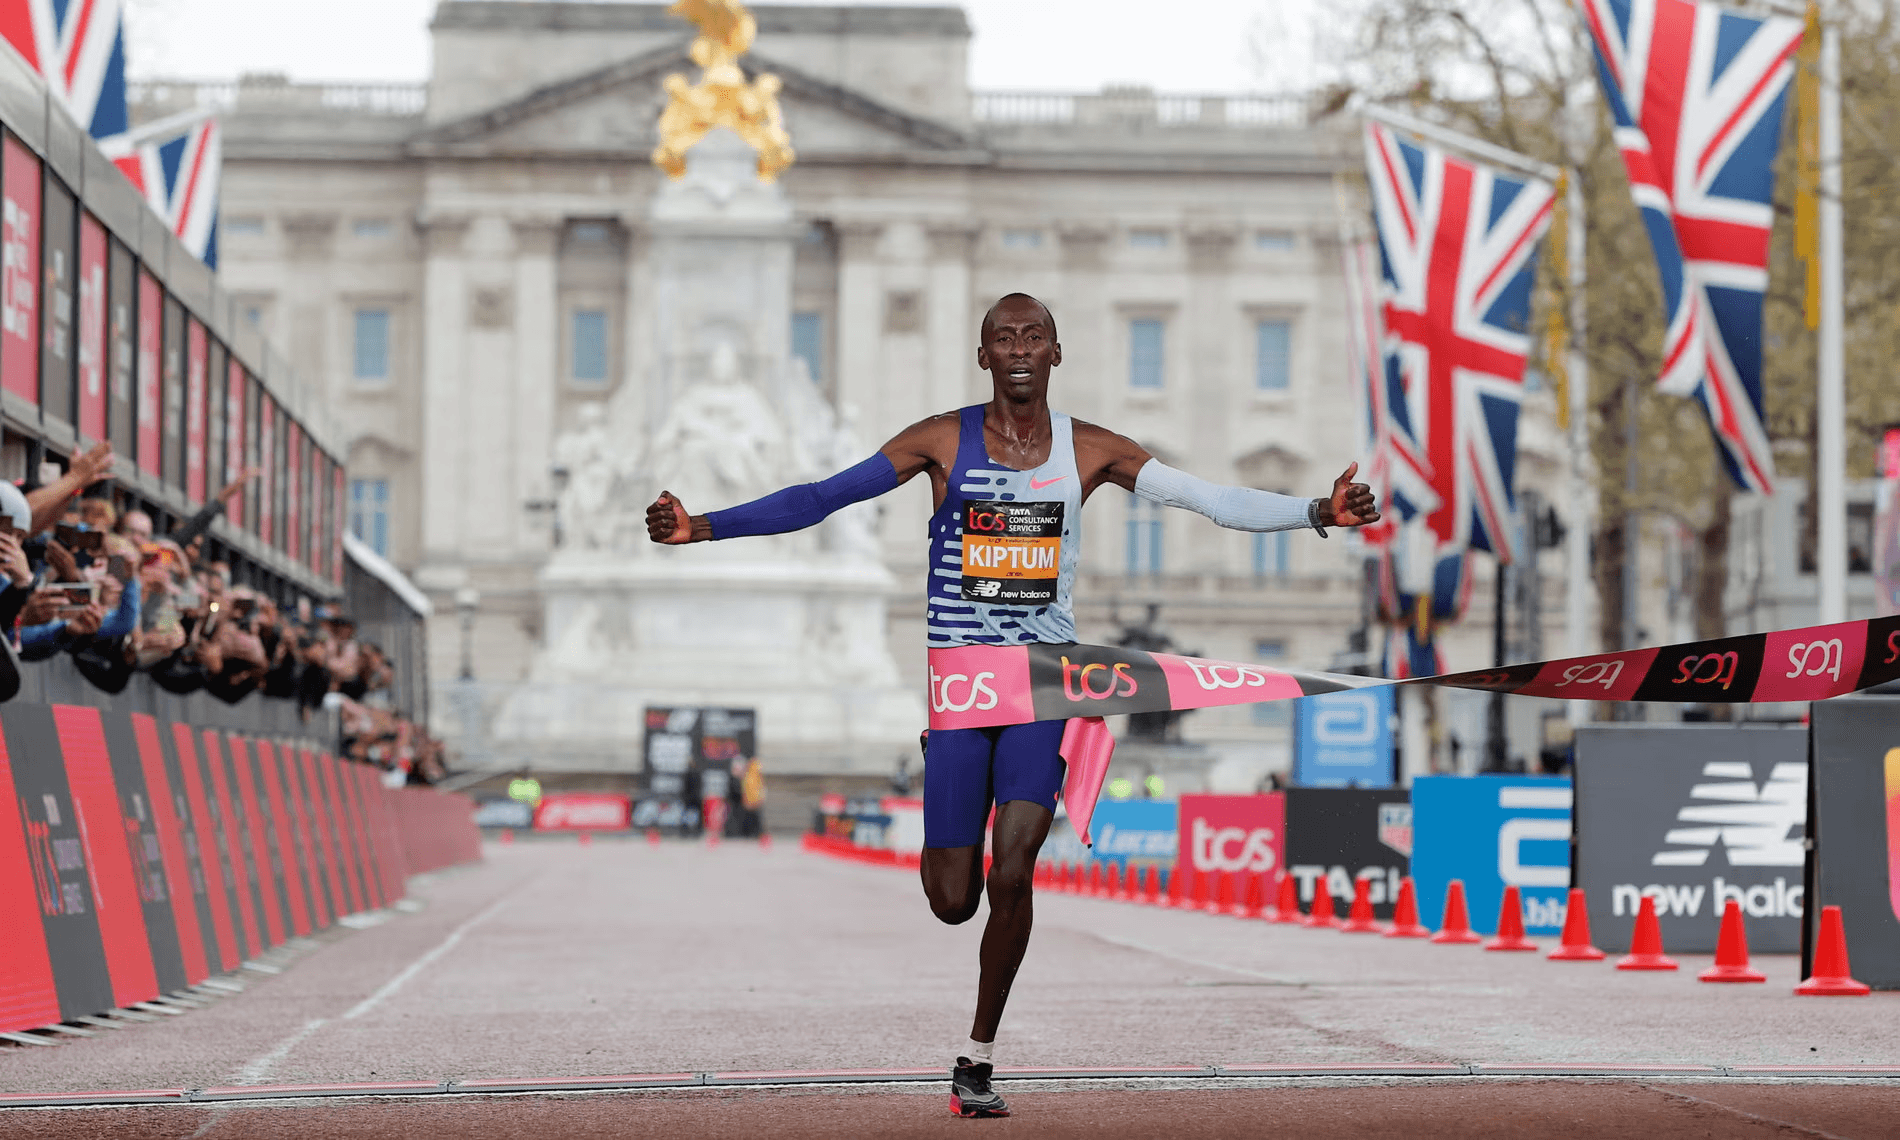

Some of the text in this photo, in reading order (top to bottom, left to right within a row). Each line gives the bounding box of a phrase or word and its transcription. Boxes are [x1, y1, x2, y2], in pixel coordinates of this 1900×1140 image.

[969, 507, 1006, 531] tcs
[1008, 516, 1058, 524] CONSULTANCY
[1009, 508, 1031, 516] TATA
[1008, 524, 1041, 532] SERVICES
[969, 544, 1055, 569] KIPTUM
[1185, 660, 1266, 690] tcs
[1555, 659, 1625, 690] tcs
[1672, 651, 1738, 690] tcs
[1786, 638, 1843, 682] tcs
[930, 664, 998, 713] tcs
[1061, 656, 1137, 701] tcs
[1192, 817, 1276, 872] tcs
[1612, 883, 1705, 917] new
